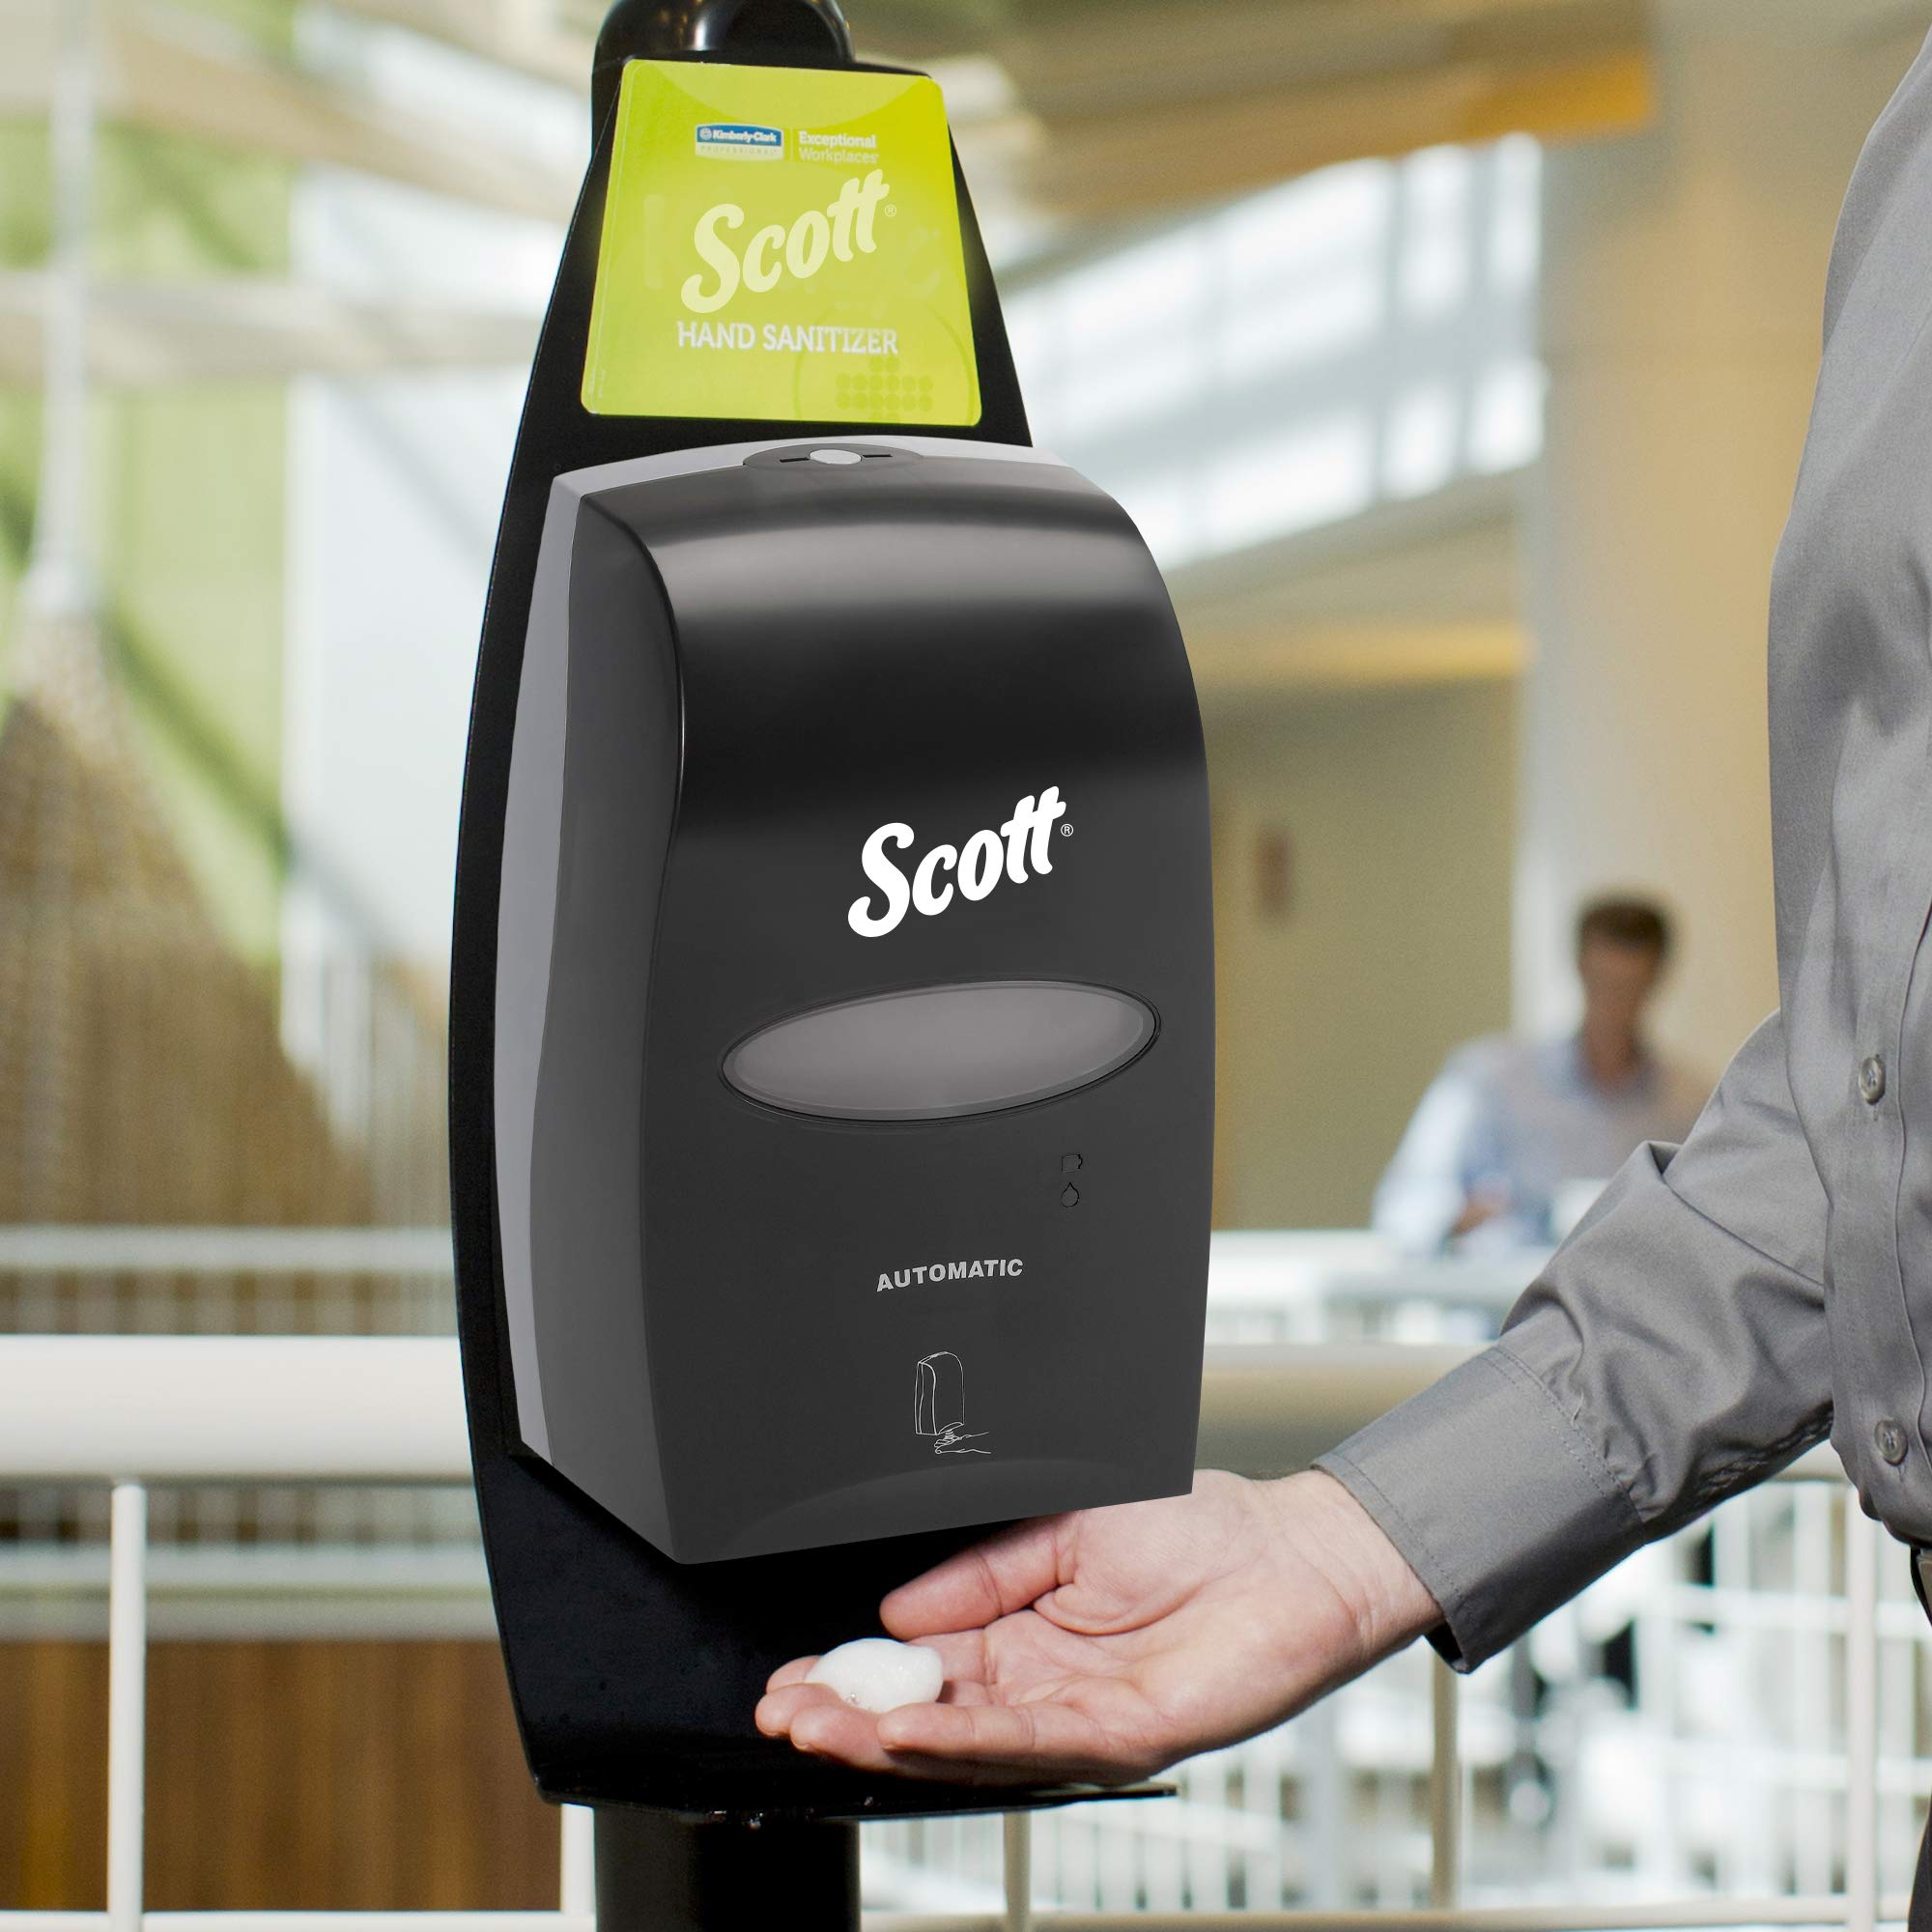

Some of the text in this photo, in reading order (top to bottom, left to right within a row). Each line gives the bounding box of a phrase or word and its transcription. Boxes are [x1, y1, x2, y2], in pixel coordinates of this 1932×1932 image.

[798, 130, 877, 149] Exceptional
[798, 146, 879, 164] Workplaces
[677, 321, 899, 355] HAND SANITIZER
[876, 1258, 1024, 1293] AUTOMATIC
